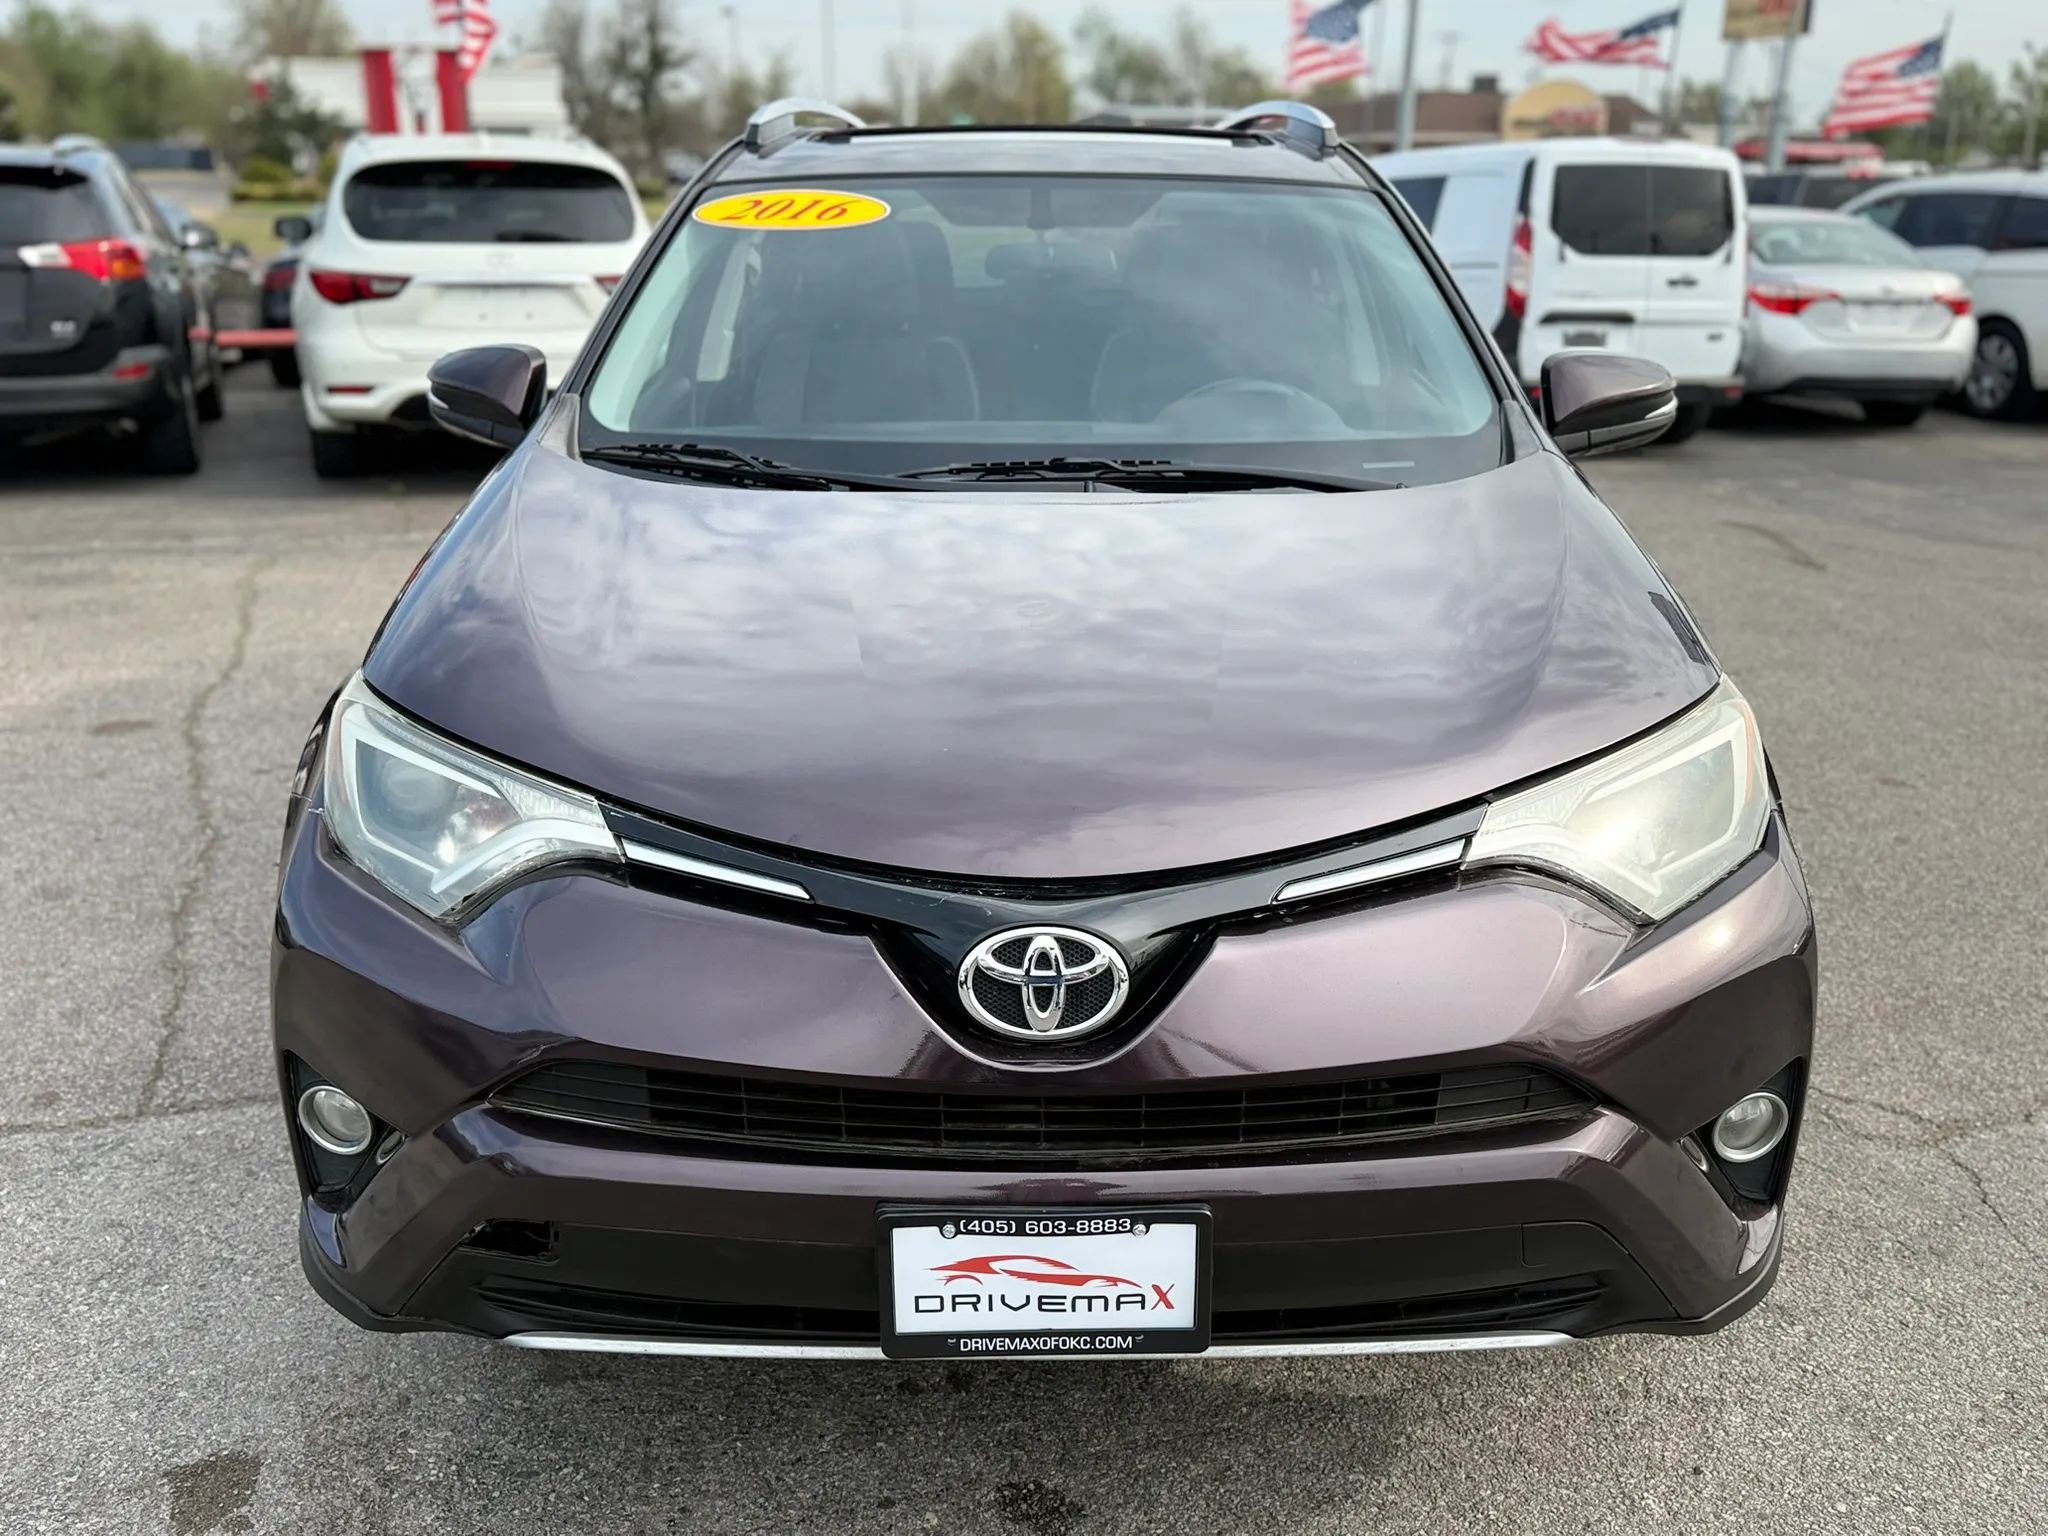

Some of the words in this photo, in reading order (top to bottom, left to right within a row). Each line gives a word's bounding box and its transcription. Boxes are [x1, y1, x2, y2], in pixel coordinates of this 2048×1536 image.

[719, 199, 861, 220] 2016
[959, 1219, 1017, 1234] (405)
[1025, 1218, 1131, 1234] 603-8883
[914, 1283, 1175, 1313] DRIVEMAX
[960, 1335, 1133, 1352] DRIVEMAXOFOKC.COM
